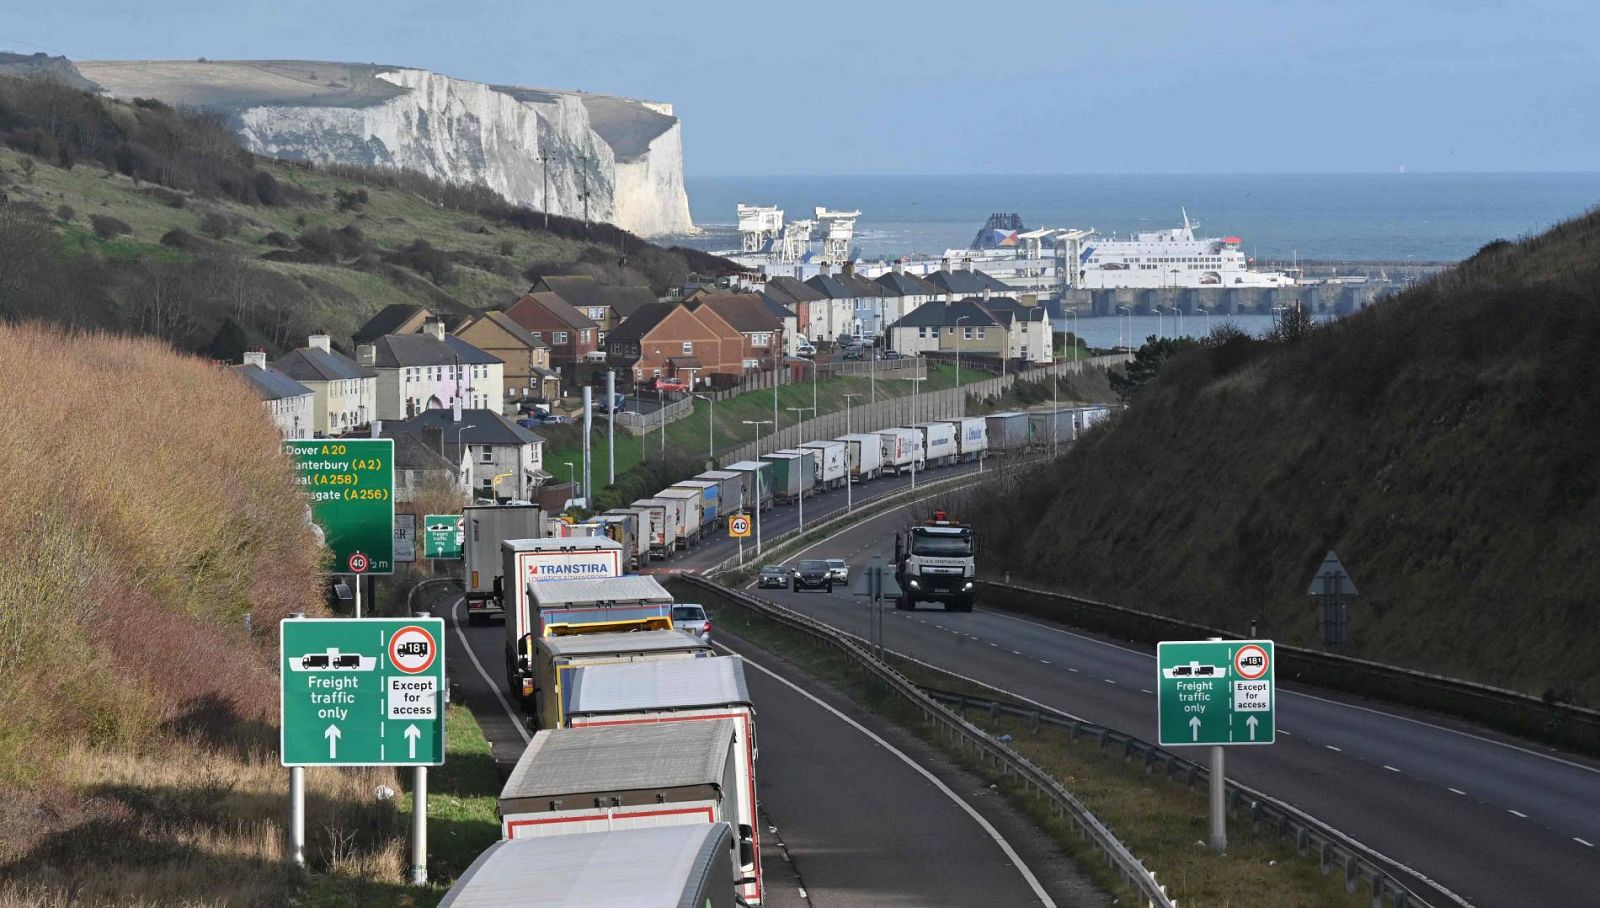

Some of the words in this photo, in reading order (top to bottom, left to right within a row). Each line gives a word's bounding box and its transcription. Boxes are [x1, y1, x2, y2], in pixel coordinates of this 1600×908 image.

[286, 445, 318, 455] Dover
[321, 445, 347, 455] A20
[295, 460, 349, 471] anterbury
[352, 458, 382, 471] (A2)
[295, 475, 312, 485] eal
[313, 473, 358, 486] (A258)
[344, 488, 388, 501] (A256)
[733, 521, 746, 530] 40
[352, 558, 364, 567] 40
[539, 563, 608, 574] TRANSTIRA
[308, 675, 358, 690] Freight
[392, 680, 433, 692] Except
[1176, 681, 1213, 692] Freight
[1237, 683, 1267, 692] Except
[311, 691, 355, 704] traffic
[404, 692, 421, 702] for
[1179, 692, 1211, 701] traffic
[1245, 692, 1258, 700] for
[393, 705, 432, 715] access
[1184, 703, 1206, 714] only
[1237, 701, 1266, 709] access
[318, 707, 348, 720] only
